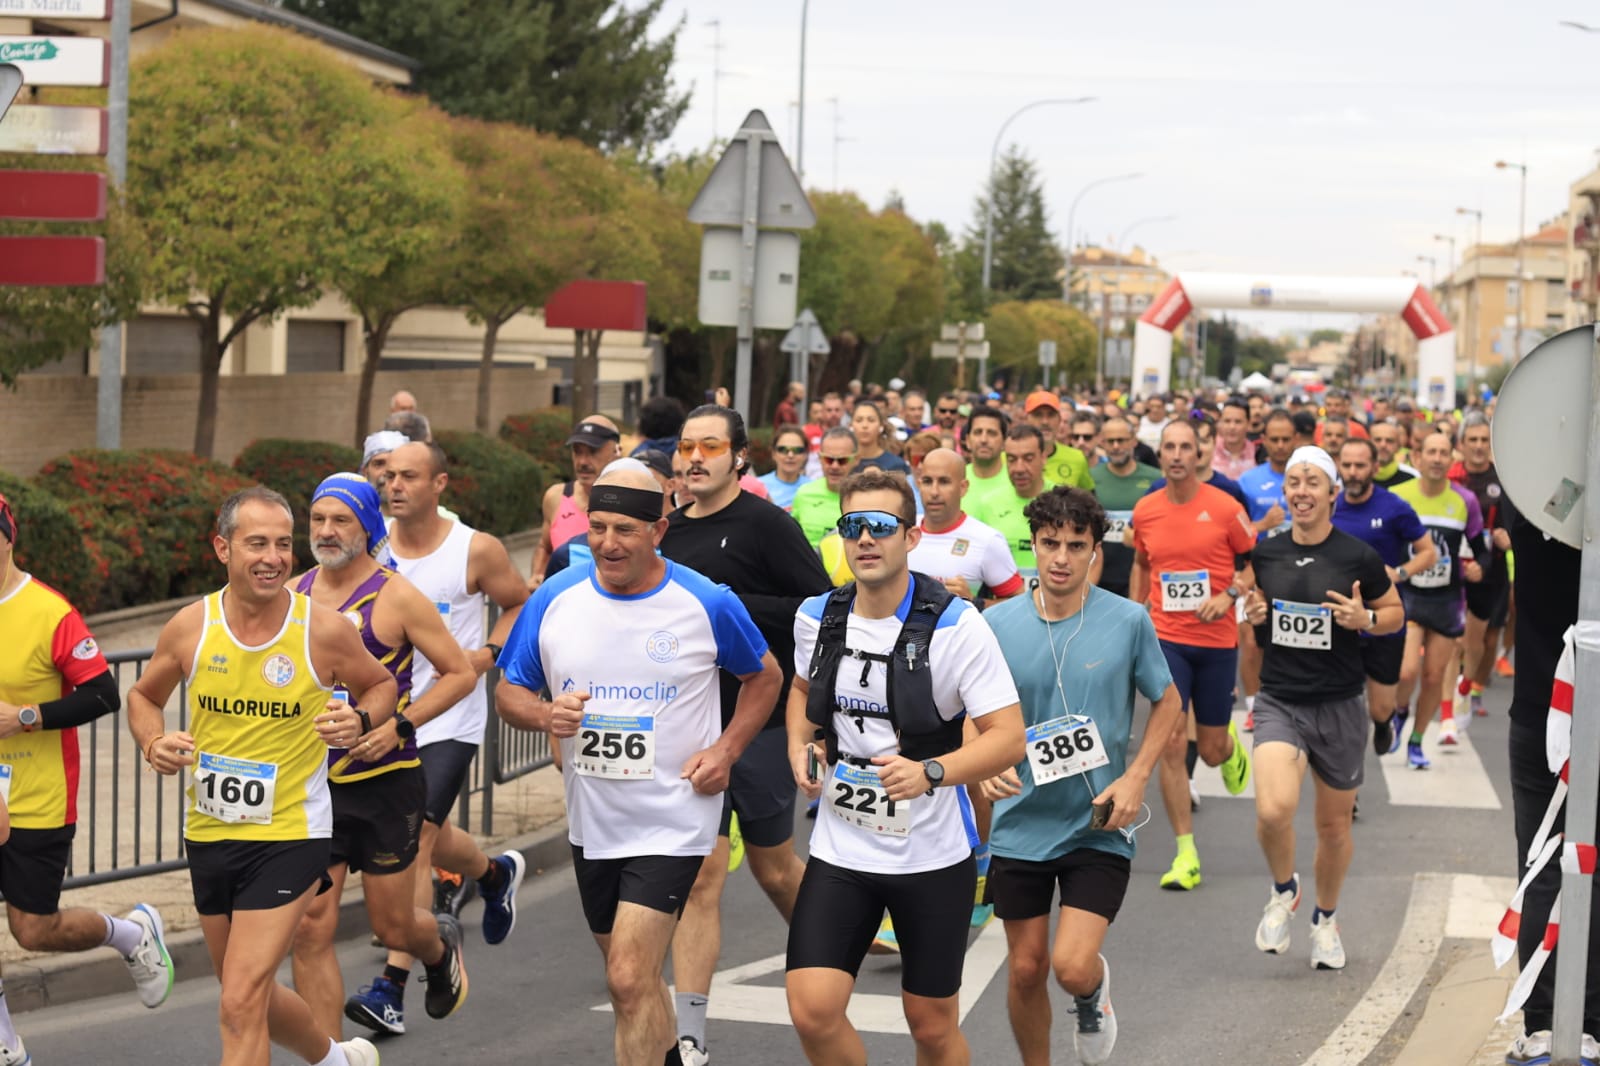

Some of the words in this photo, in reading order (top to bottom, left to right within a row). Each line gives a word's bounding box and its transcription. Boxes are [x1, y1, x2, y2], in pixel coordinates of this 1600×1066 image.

[1167, 582, 1205, 599] 623
[1278, 614, 1325, 636] 602
[198, 693, 301, 719] VILLORUELA
[588, 681, 678, 704] inmoclip
[581, 730, 646, 760] 256
[1034, 728, 1094, 765] 386
[201, 772, 265, 807] 160
[834, 782, 896, 817] 221
